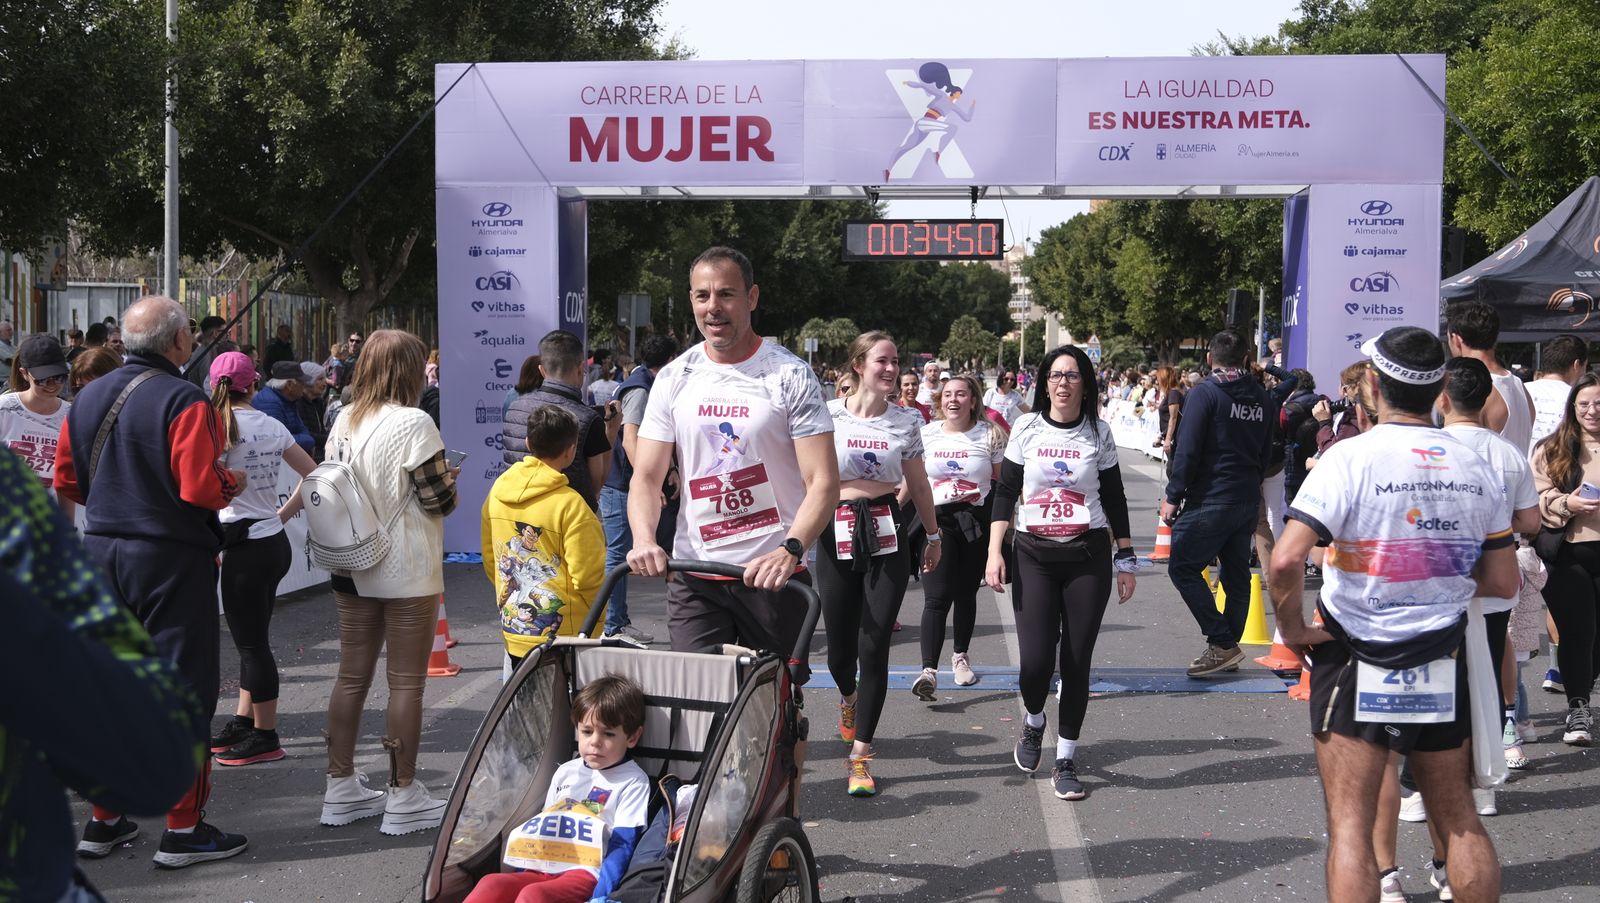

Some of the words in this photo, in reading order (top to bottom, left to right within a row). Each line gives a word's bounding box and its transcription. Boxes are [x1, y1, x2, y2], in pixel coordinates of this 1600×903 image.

[1124, 79, 1150, 98] LA
[1158, 78, 1275, 98] IGUALDAD
[581, 85, 688, 105] CARRERA
[696, 84, 726, 104] DE
[734, 84, 762, 104] LA
[1088, 111, 1117, 130] ES
[1122, 110, 1234, 130] NUESTRA
[1238, 109, 1311, 129] META.
[569, 115, 775, 162] MUJER
[1098, 143, 1134, 161] CDX
[1175, 142, 1217, 153] ALMERÍA
[471, 219, 523, 227] HYUNDAI
[1348, 218, 1404, 226] HYUNDAI
[1355, 227, 1398, 235] Almerialva
[868, 223, 996, 256] 00:34:50
[485, 246, 527, 257] cajamar
[1361, 246, 1407, 258] cajamar
[488, 301, 526, 312] vithas
[1363, 304, 1404, 315] vithas
[481, 334, 525, 347] aqualia
[485, 382, 514, 391] Clece
[698, 404, 750, 418] MUJER
[1229, 402, 1264, 422] NEXA
[847, 438, 889, 450] MUJER
[934, 451, 969, 459] MUJER
[1037, 448, 1081, 460] MUJER
[709, 488, 755, 514] 768
[723, 507, 749, 518] MANOLO
[1039, 503, 1074, 518] 738
[1383, 664, 1431, 685] 261
[520, 815, 593, 843] BEBÉ
